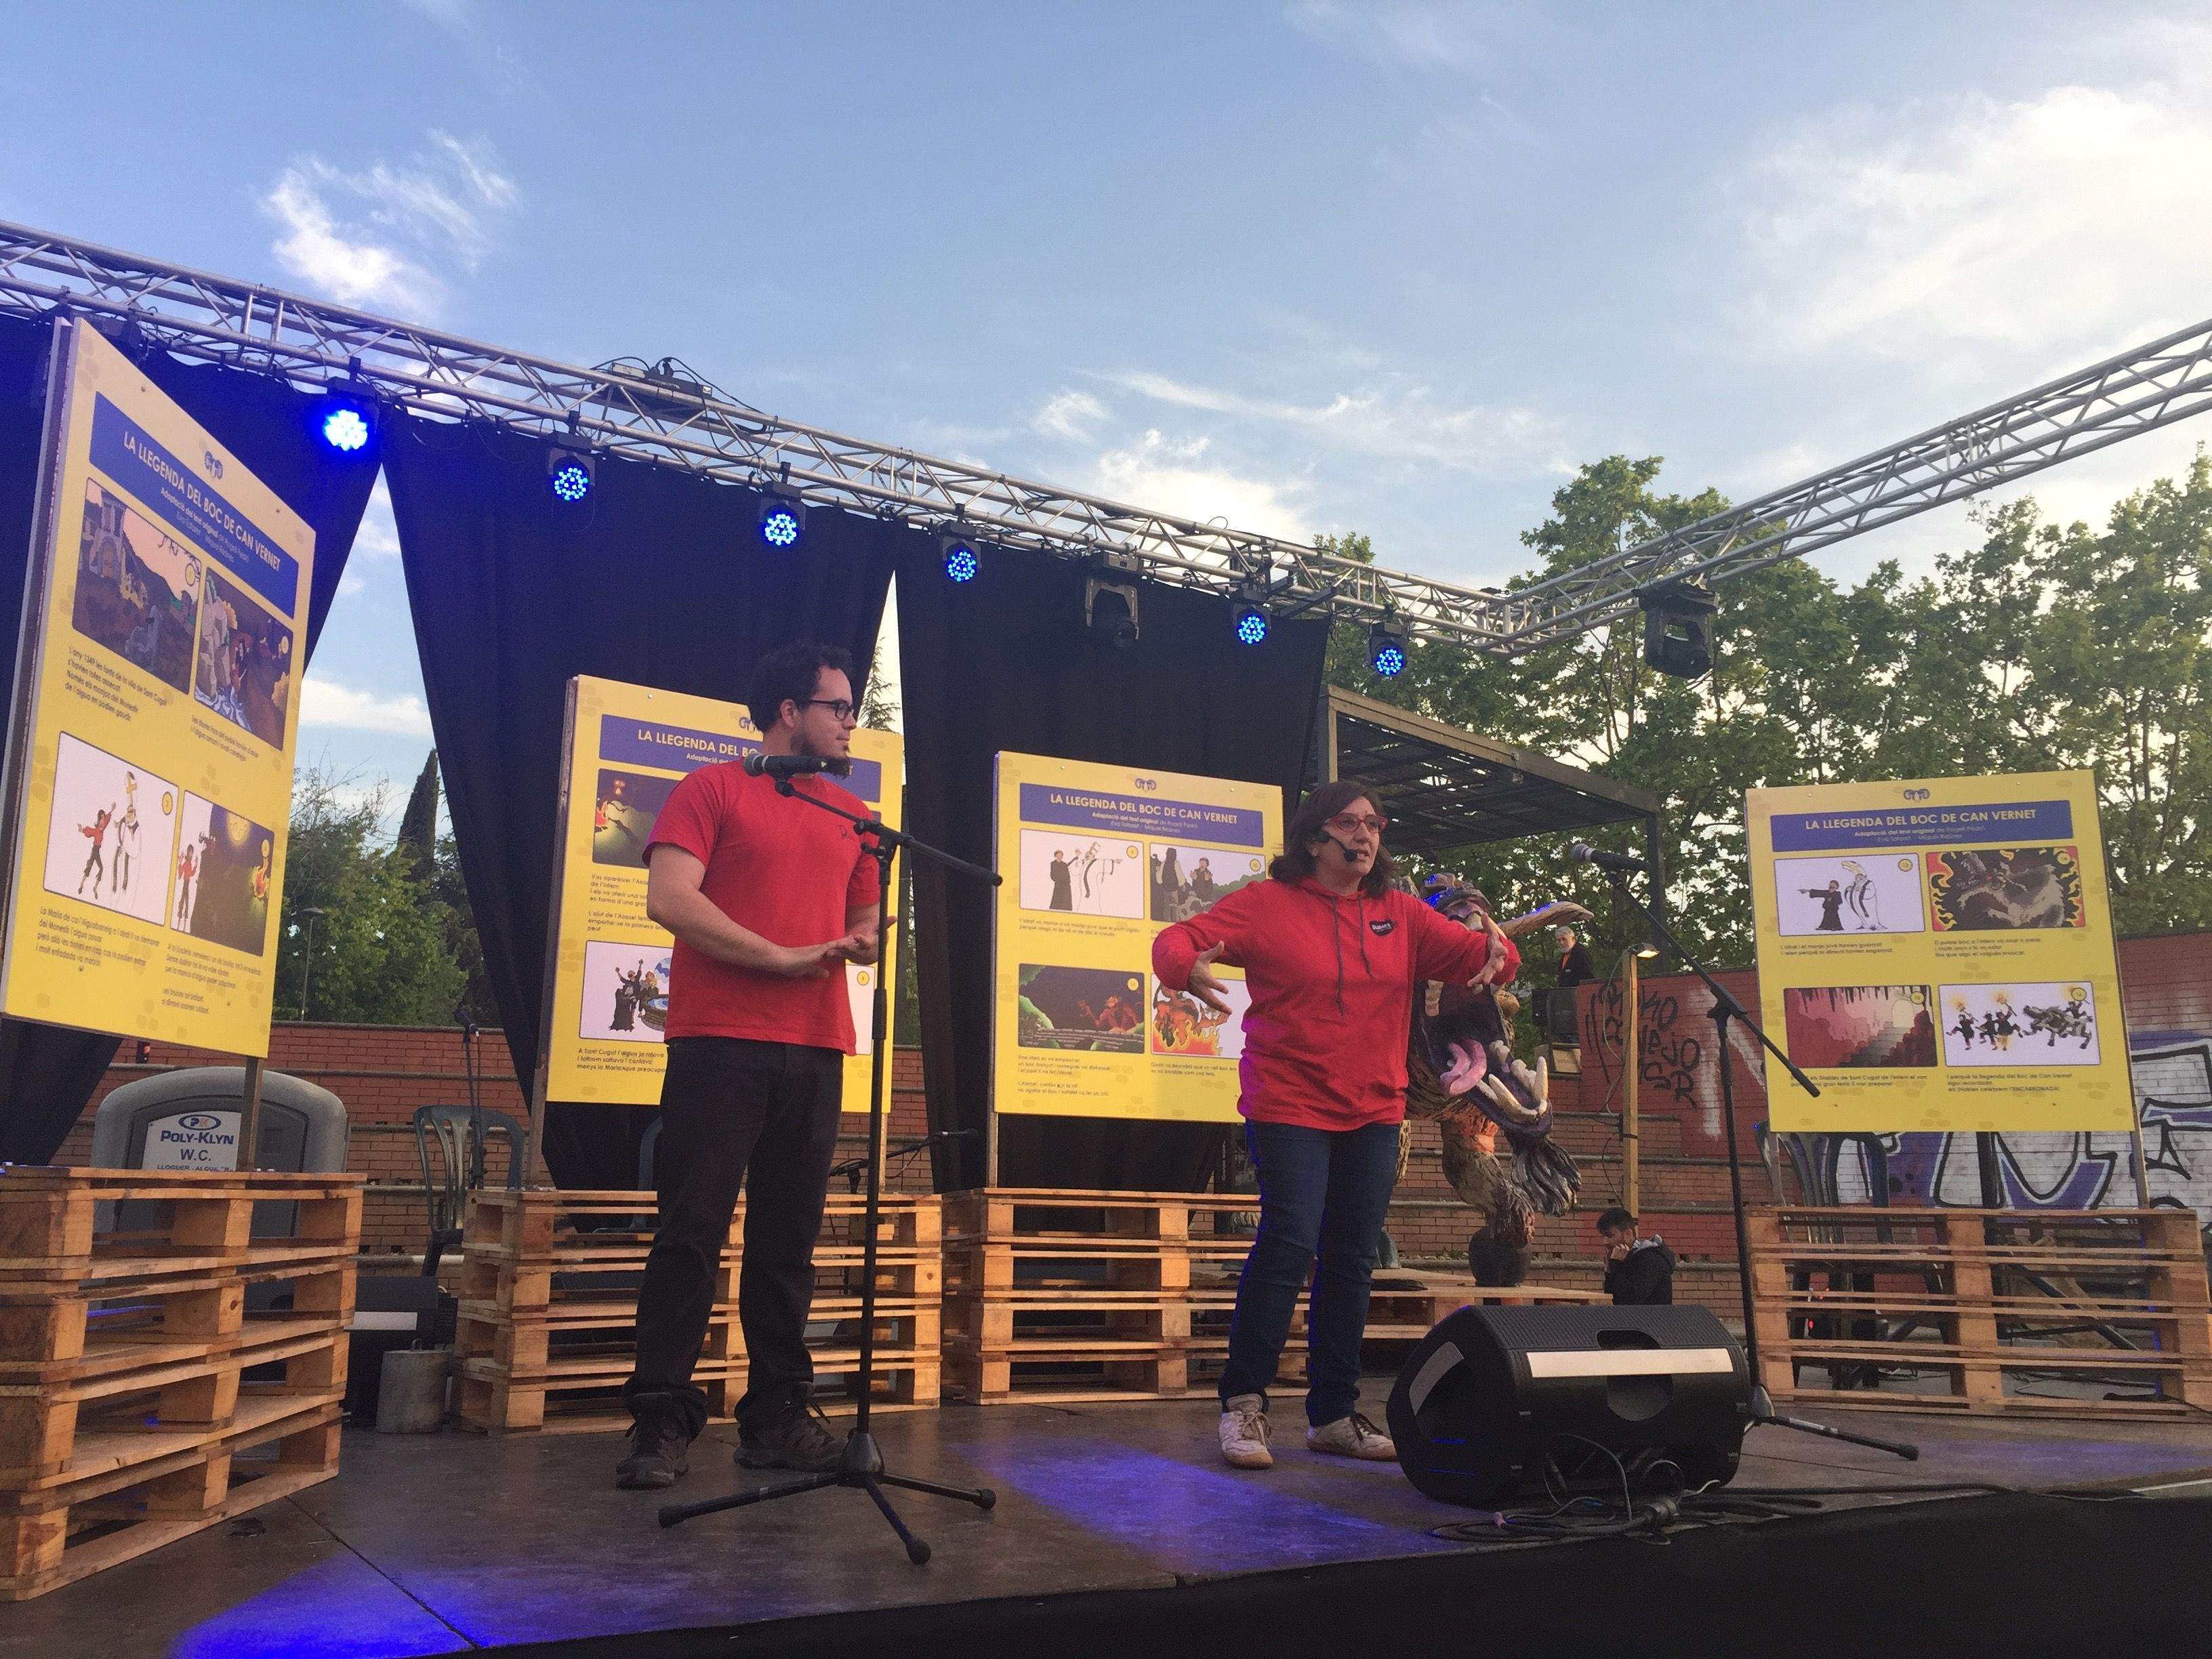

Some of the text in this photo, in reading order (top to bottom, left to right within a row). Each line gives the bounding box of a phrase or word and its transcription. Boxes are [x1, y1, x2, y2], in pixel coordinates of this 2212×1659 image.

[124, 431, 136, 454] LA
[139, 443, 184, 494] LLEGENDA
[187, 483, 201, 508] DEL
[204, 498, 222, 523] BOC
[224, 514, 234, 535] DE
[237, 525, 253, 550] CAN
[255, 539, 281, 571] VERNET
[638, 729, 652, 741] LA
[656, 732, 716, 752] LLEGENDA
[719, 743, 739, 756] DEL
[1050, 794, 1237, 825] LA LLEGENDA DEL BOC DE CAN VERNET
[1805, 809, 2036, 830] LA LLEGENDA DEL BOC DE CAN VERNET
[160, 1130, 234, 1145] POLY-KLYN
[180, 1149, 211, 1162] W.C.
